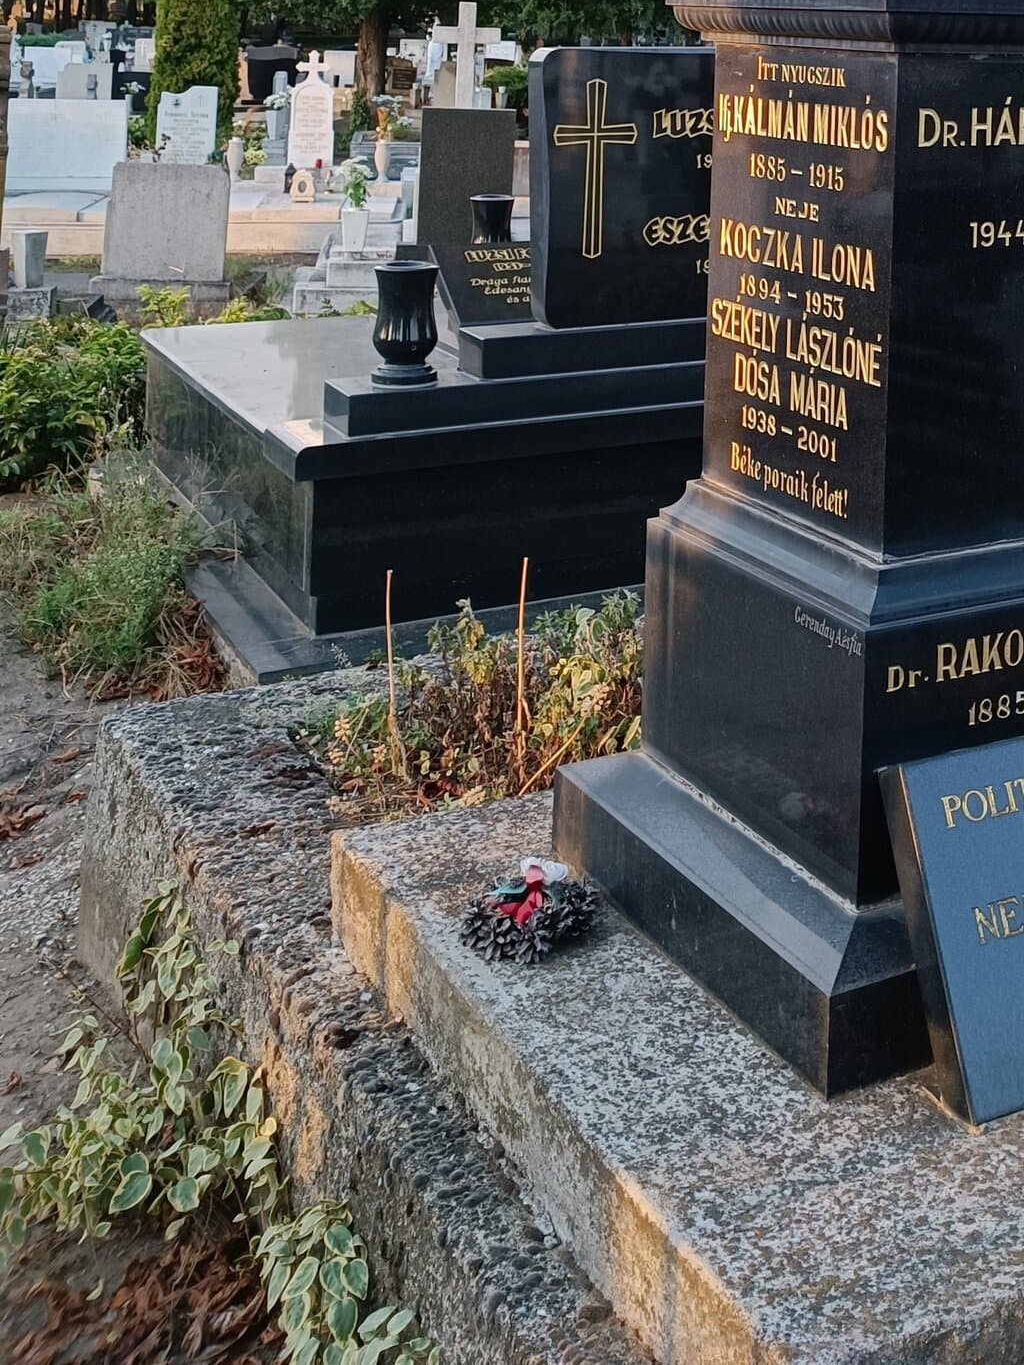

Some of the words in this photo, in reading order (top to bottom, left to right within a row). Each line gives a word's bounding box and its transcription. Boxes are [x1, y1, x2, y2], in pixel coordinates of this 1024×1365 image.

[758, 56, 778, 81] ITT
[781, 65, 846, 88] NYUGSZIK
[813, 95, 888, 152] MIKLÓS
[750, 153, 786, 182] 1885
[809, 162, 844, 191] 1915
[775, 196, 819, 222] NEJE
[720, 217, 804, 275] KOCZKA
[811, 237, 876, 292] ILONA
[739, 273, 781, 305] 1894
[805, 289, 844, 321] 1953
[711, 293, 781, 354] SZÉKELY
[786, 311, 883, 388] LÁSZLÓNÉ
[734, 348, 781, 407] DÓSA
[789, 367, 848, 431] MÁRIA
[741, 404, 776, 437] 1938
[797, 426, 837, 463] 2001
[730, 441, 761, 481] Béke
[763, 464, 808, 502] poraik
[811, 471, 848, 519] felett!
